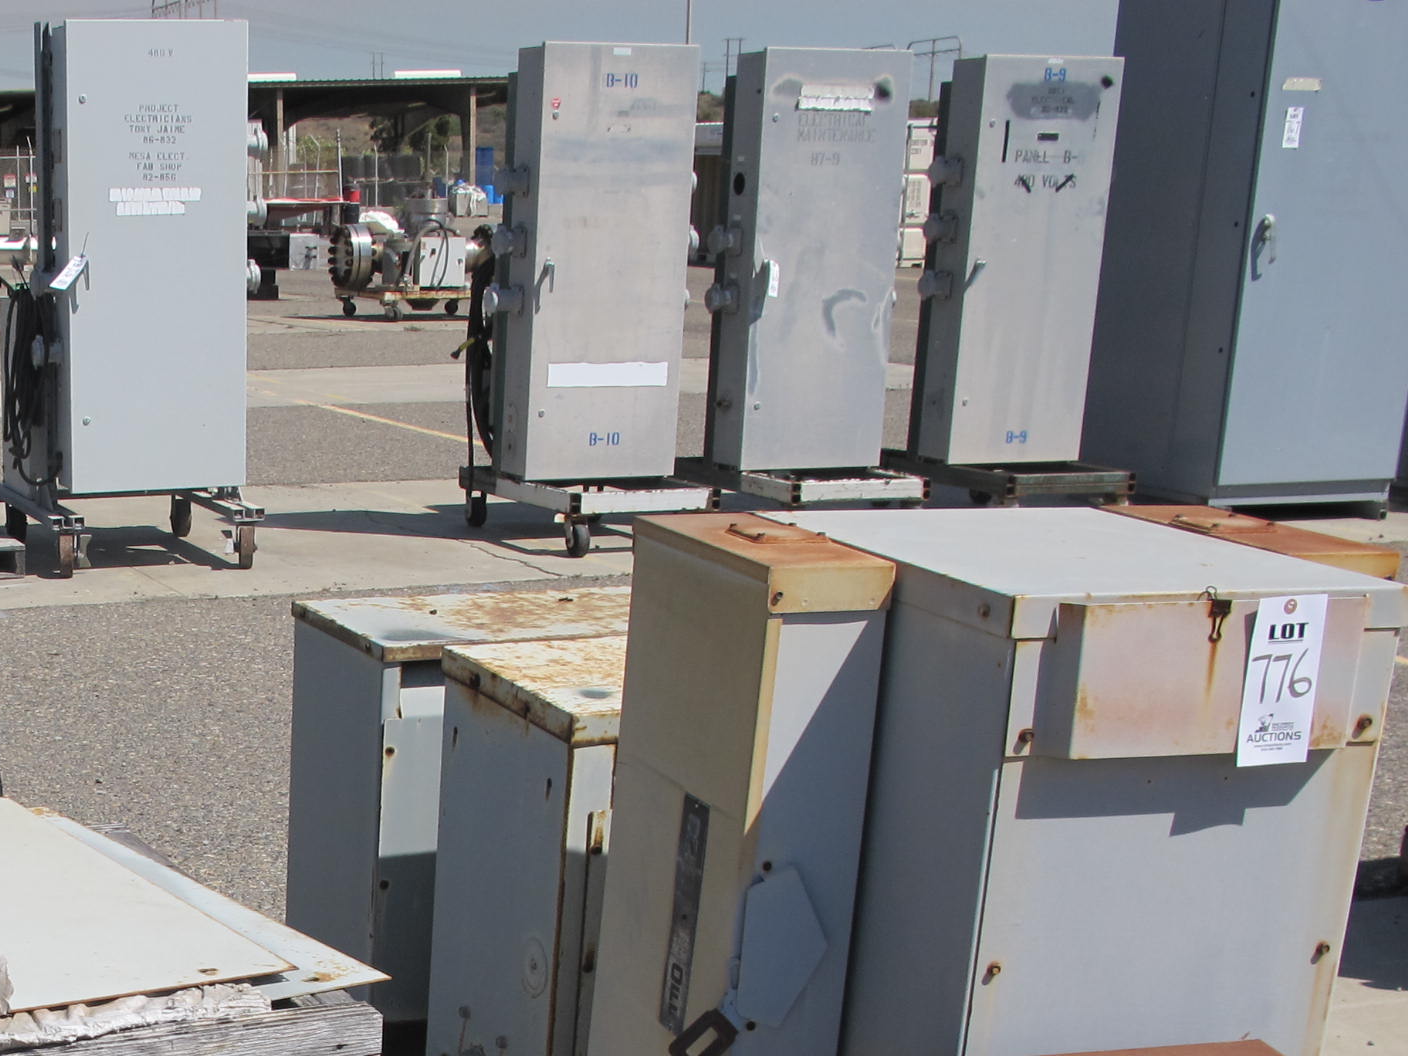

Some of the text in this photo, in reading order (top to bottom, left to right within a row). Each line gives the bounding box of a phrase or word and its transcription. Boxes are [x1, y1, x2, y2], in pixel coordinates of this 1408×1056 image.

[606, 73, 639, 88] B-10
[138, 104, 180, 113] PROJECT
[124, 114, 192, 123] ELECTRICIANS
[129, 125, 186, 134] TONY JAIME
[1015, 150, 1049, 164] PANEL
[589, 431, 620, 447] B-10
[1005, 430, 1028, 444] B-9
[1267, 622, 1309, 641] LOT
[1251, 648, 1313, 704] 776
[1246, 730, 1303, 744] AUCTIONS
